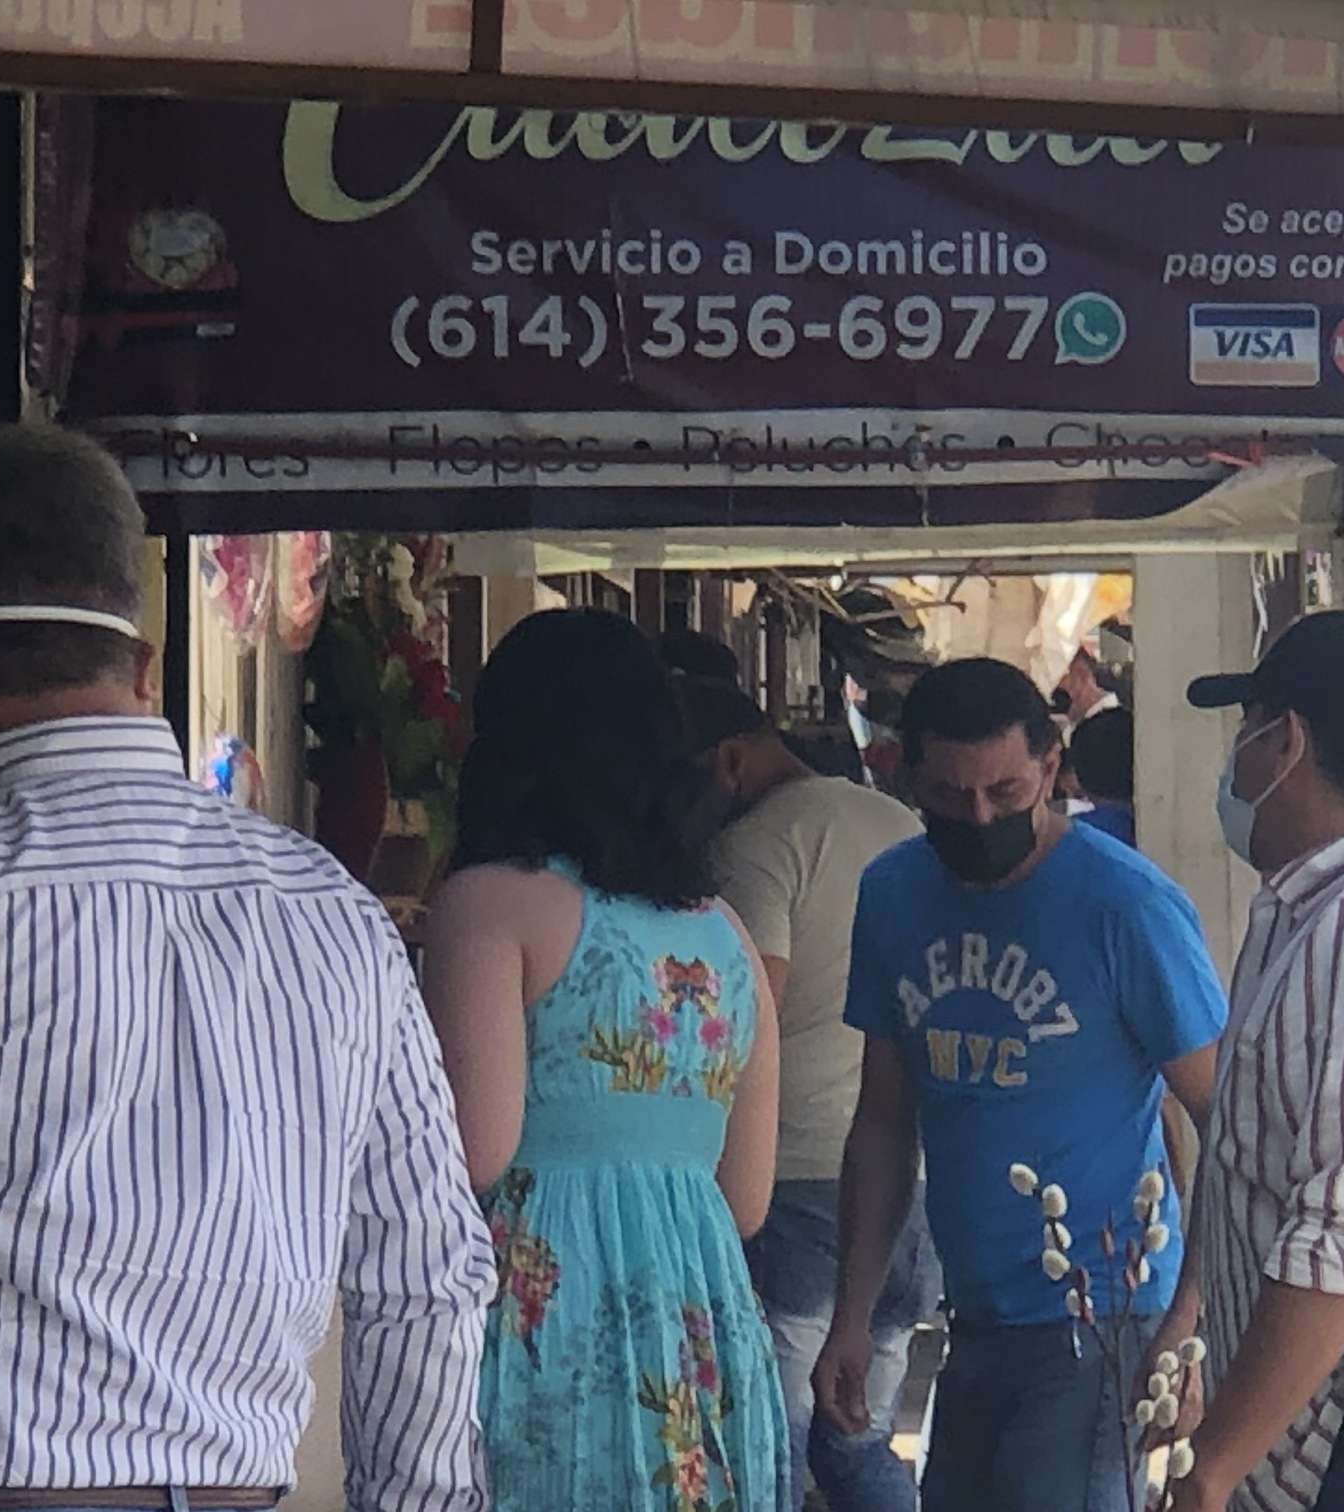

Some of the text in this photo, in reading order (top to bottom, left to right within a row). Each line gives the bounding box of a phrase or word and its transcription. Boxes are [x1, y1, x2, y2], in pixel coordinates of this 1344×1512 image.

[1222, 202, 1268, 235] Se
[469, 229, 1049, 277] Servicio a Domicilio
[1163, 252, 1278, 284] pagos
[390, 294, 1049, 368] (614) 356-6977
[1213, 329, 1295, 358] VISA
[926, 1028, 1028, 1087] NYC
